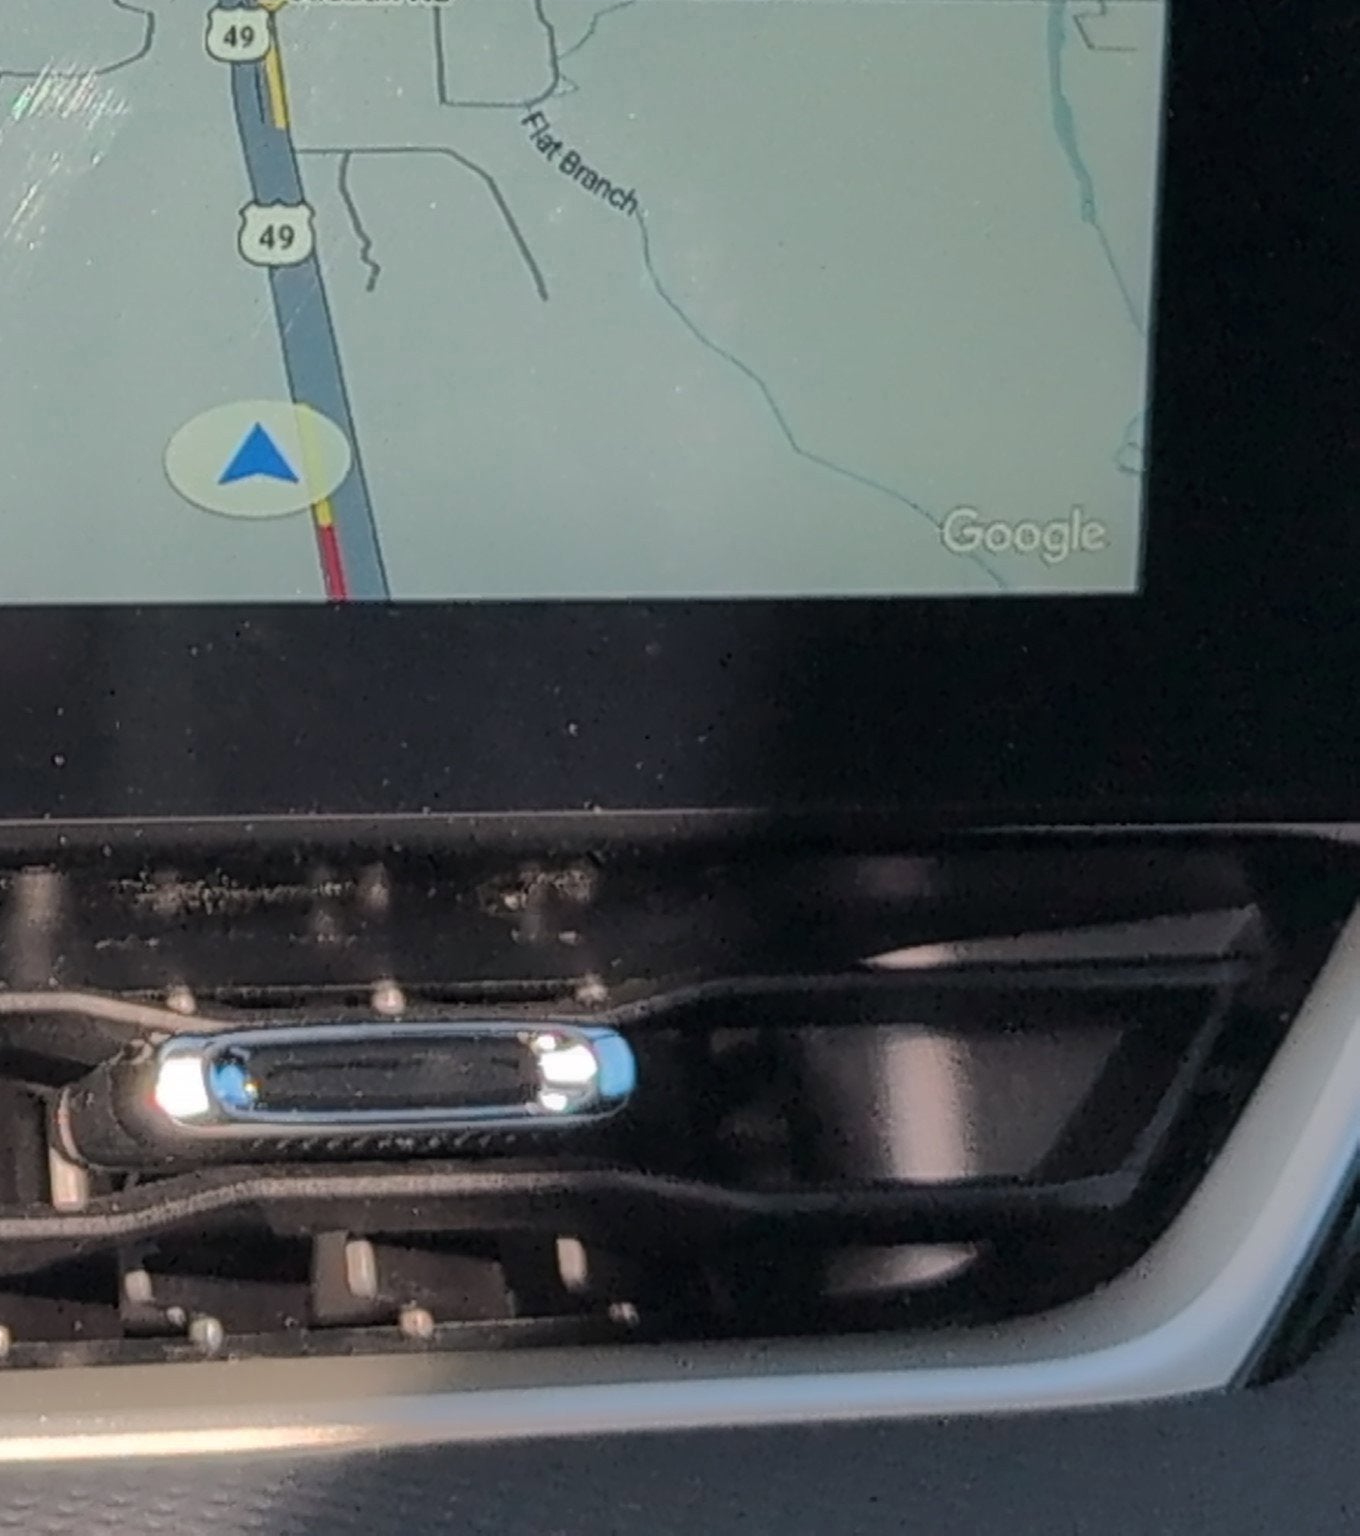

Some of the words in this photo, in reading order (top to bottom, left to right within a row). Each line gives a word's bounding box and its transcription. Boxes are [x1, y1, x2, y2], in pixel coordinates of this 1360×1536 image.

[222, 25, 255, 48] 49
[521, 110, 565, 161] Flat
[558, 150, 640, 216] Branch
[258, 225, 295, 250] 49
[942, 507, 1107, 564] Google
